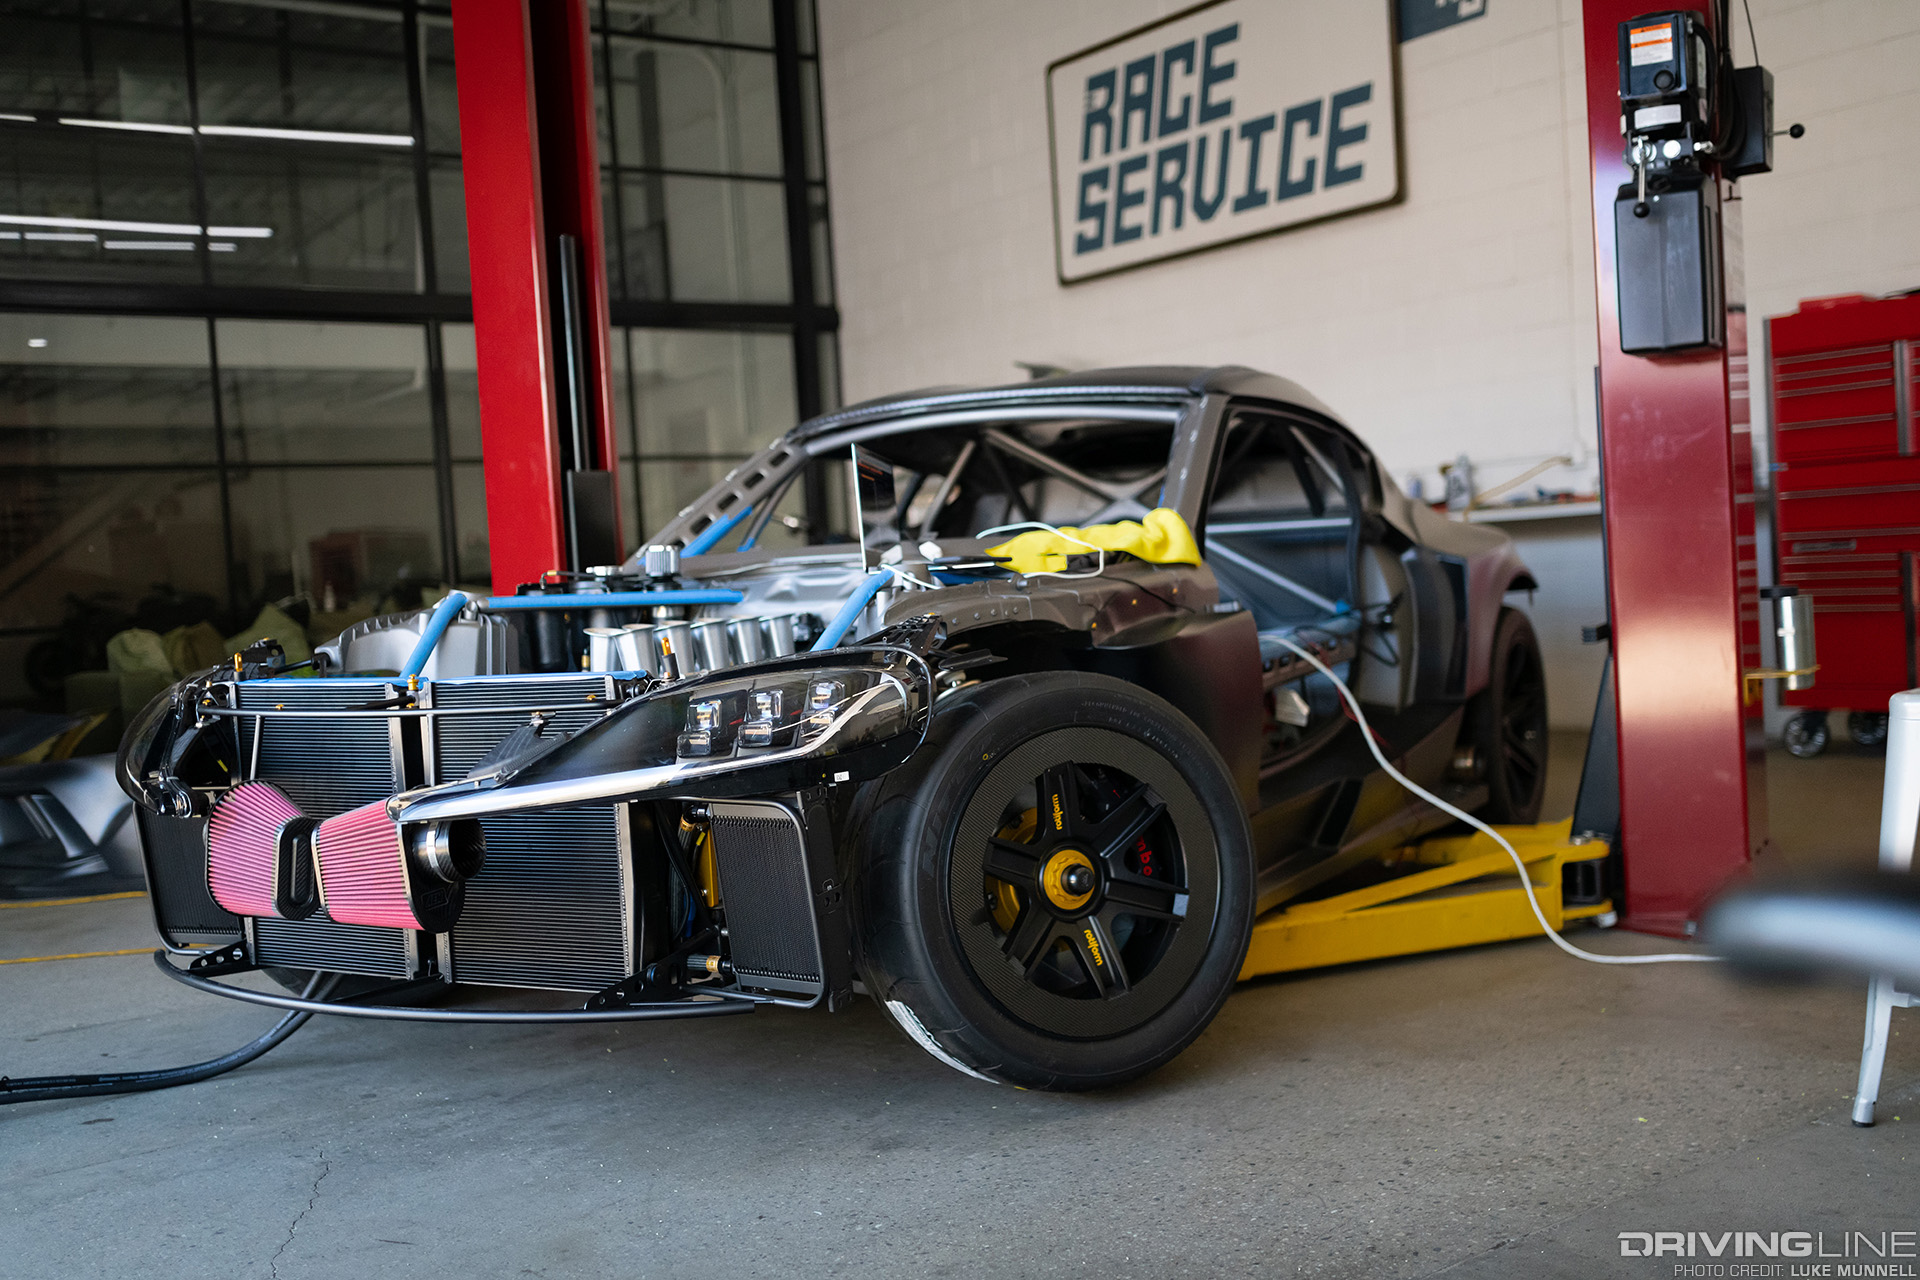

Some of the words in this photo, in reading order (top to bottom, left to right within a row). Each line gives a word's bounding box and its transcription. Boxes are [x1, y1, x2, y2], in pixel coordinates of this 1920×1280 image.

[1081, 22, 1242, 162] RACE
[1074, 81, 1374, 256] SERVICE
[1051, 793, 1064, 831] rotiform
[1083, 928, 1103, 966] rotiform
